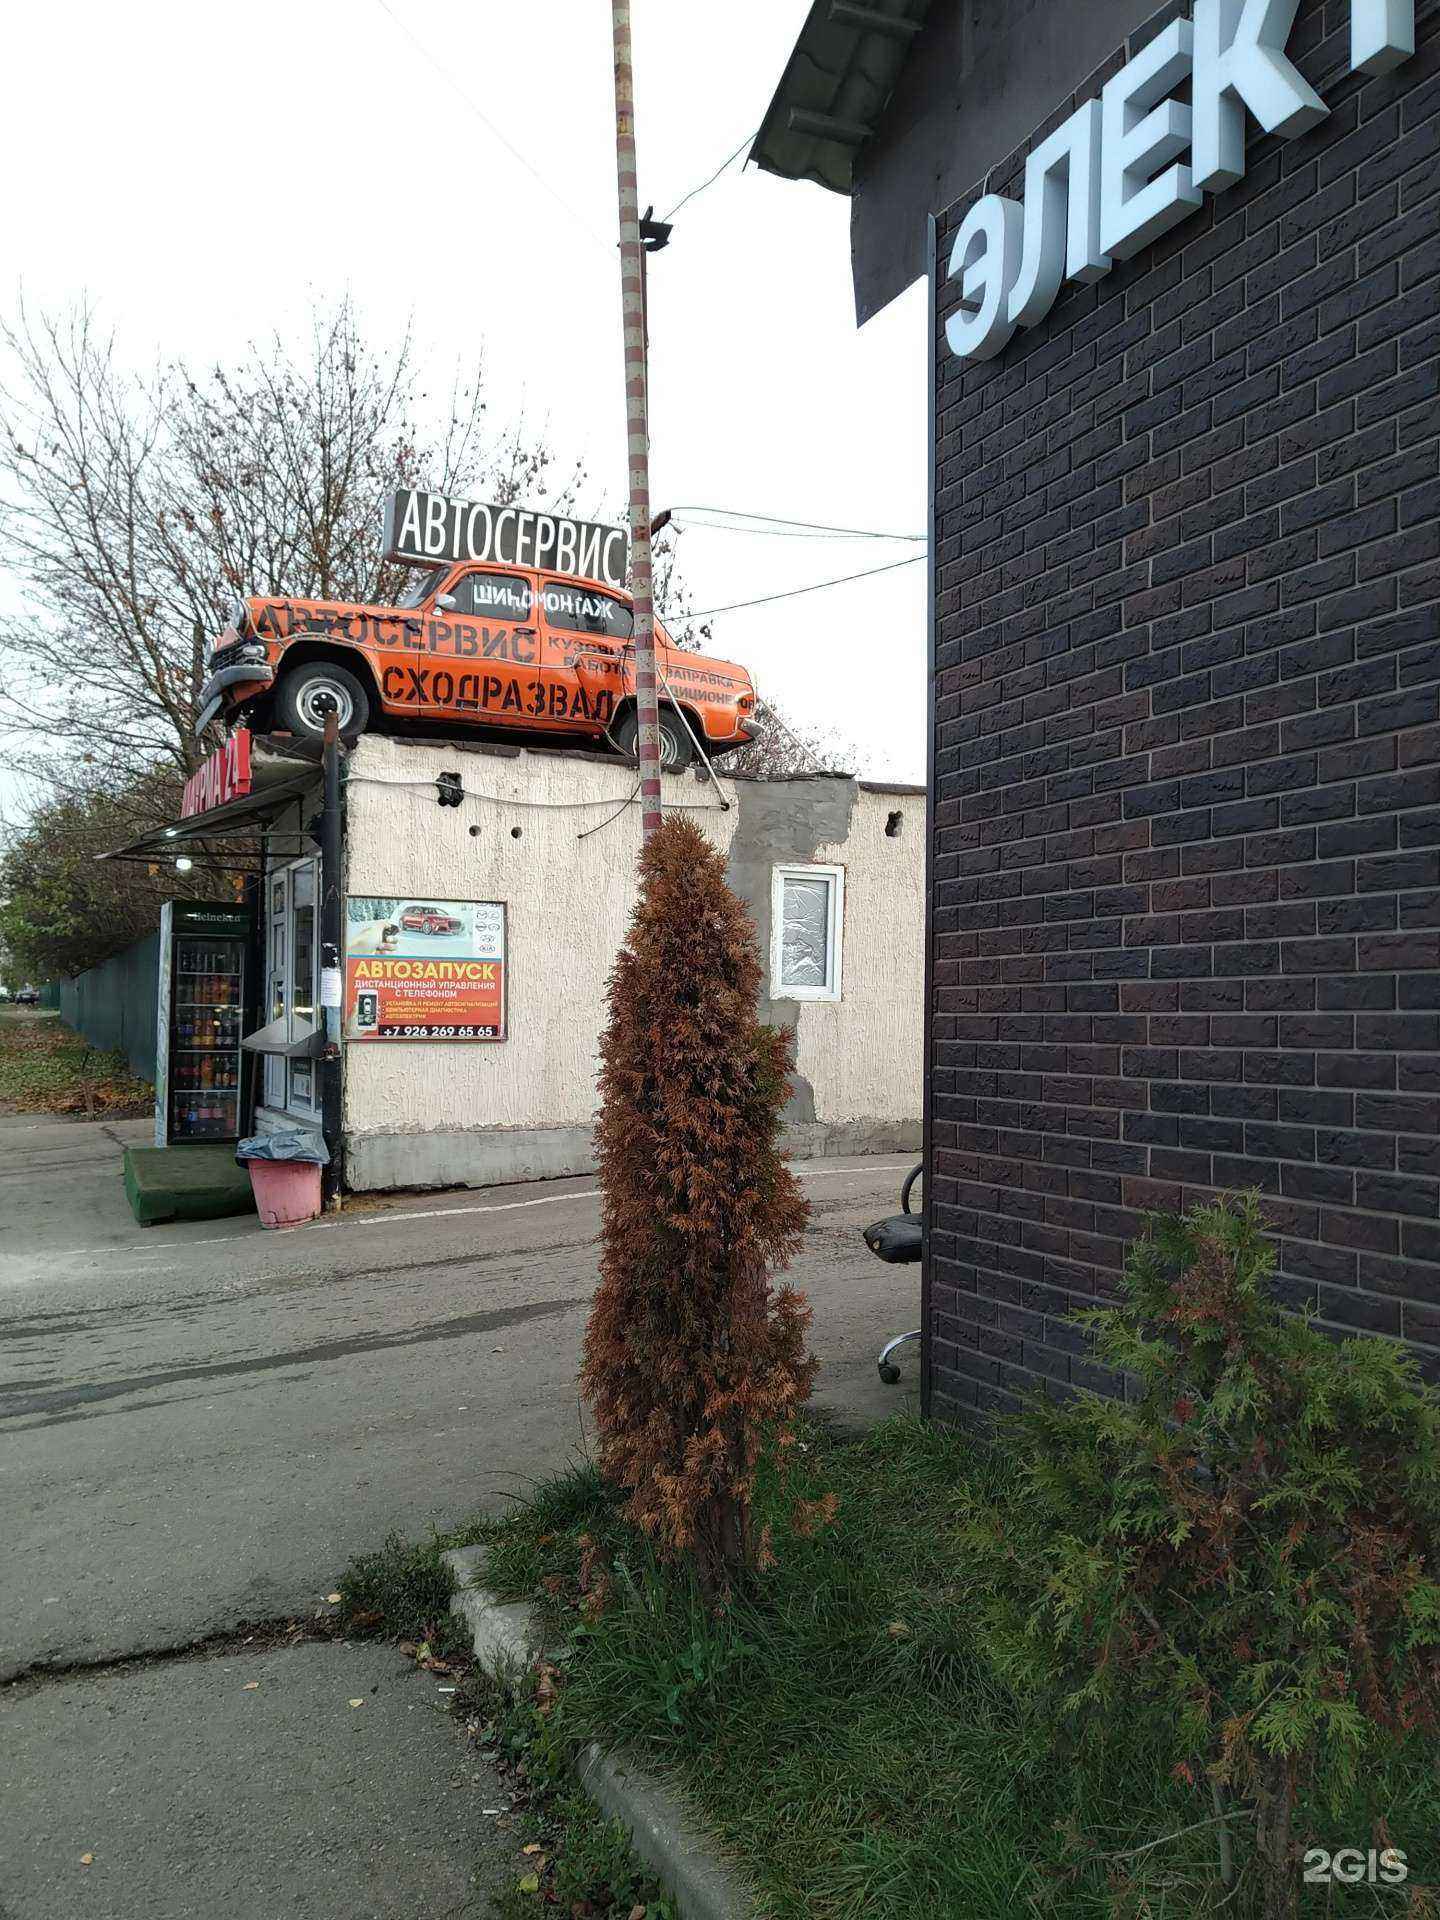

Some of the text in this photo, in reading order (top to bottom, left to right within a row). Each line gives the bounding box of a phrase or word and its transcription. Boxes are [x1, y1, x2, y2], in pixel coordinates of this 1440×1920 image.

[397, 489, 623, 588] АВТОСЕРВИС
[382, 665, 614, 724] СХОДРАЗВАЛ
[354, 960, 496, 980] АВТОЗАПУСК
[354, 979, 496, 990] ДИСТАНЦИОННЫЙ УПРАВЛЕНИЯ
[403, 990, 458, 998] ТЕЛЕФОНОМ
[384, 1026, 493, 1036] +7 926 269 65 65
